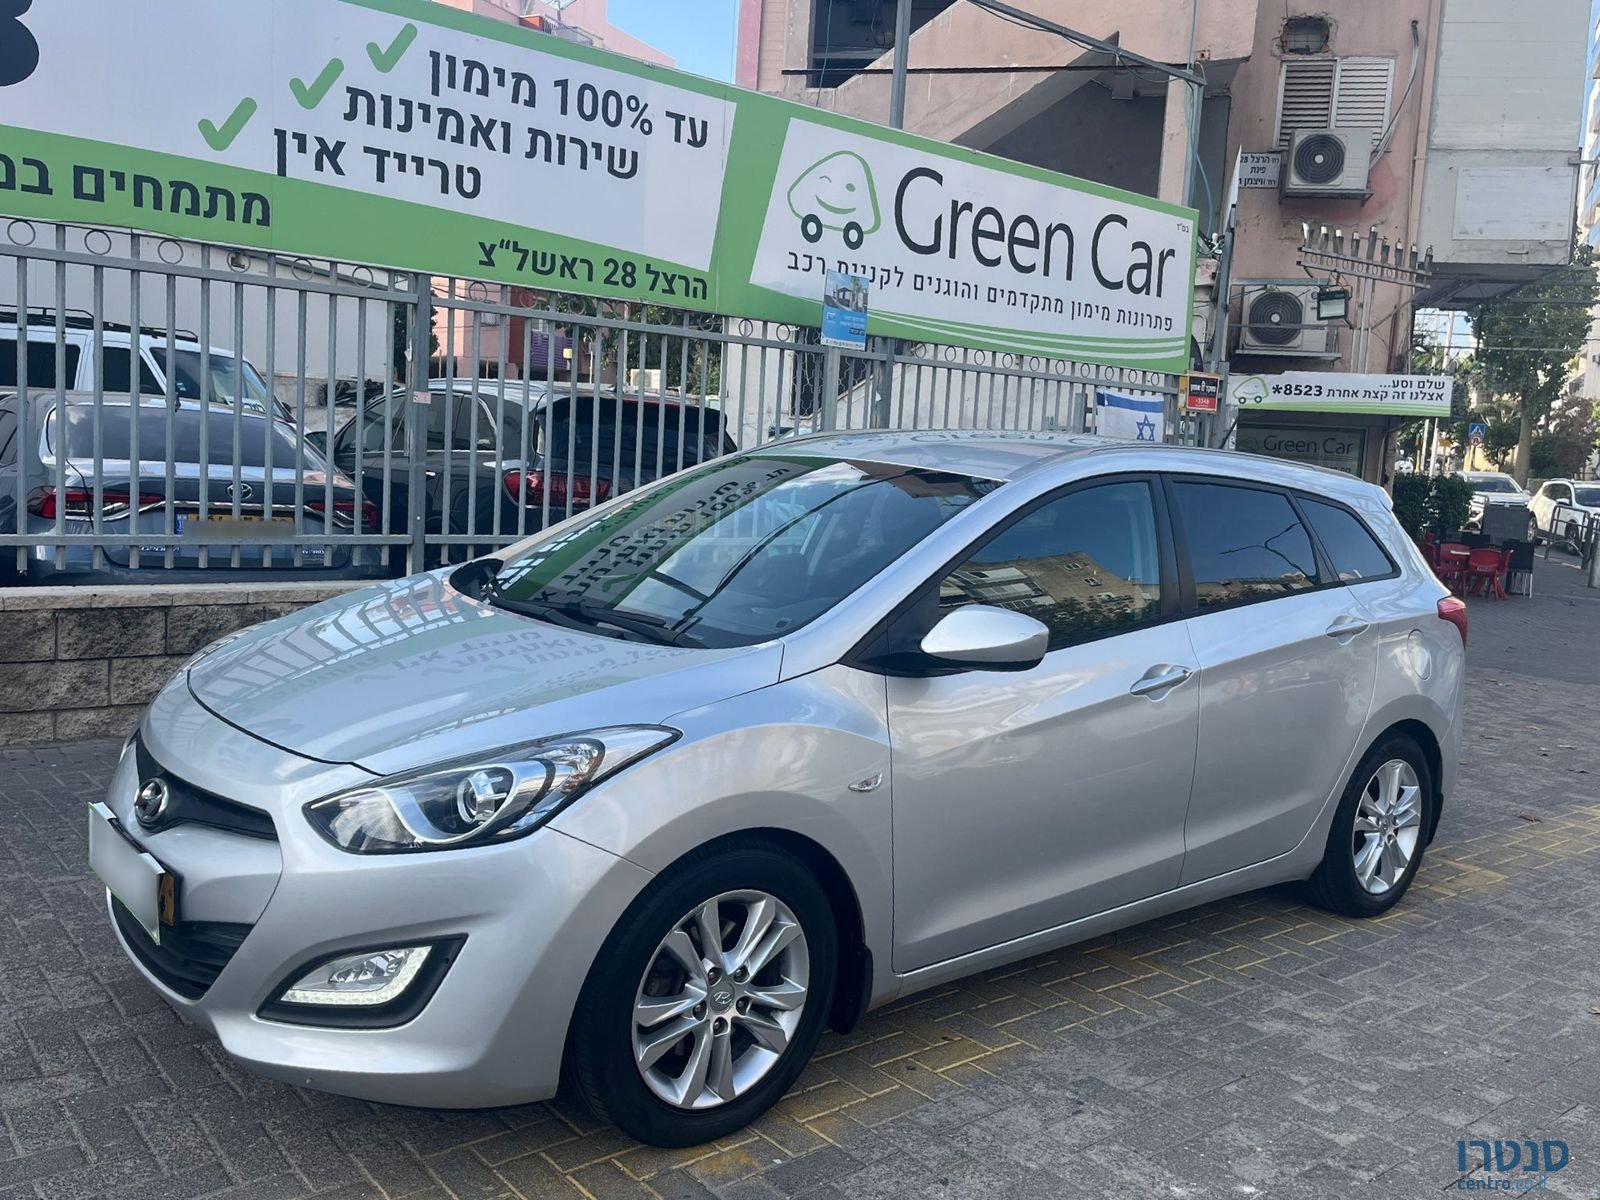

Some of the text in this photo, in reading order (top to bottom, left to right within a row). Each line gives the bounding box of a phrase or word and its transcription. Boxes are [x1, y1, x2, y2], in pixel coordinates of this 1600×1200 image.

[430, 50, 708, 148] עד 100% מימון
[343, 86, 638, 179] שירות ואמינות
[274, 128, 481, 199] טרייד אין
[1250, 166, 1266, 174] פינת
[1251, 154, 1270, 164] הרצל
[73, 164, 271, 227] מתמחים
[894, 167, 1175, 298] Green Car
[603, 258, 637, 289] 28
[787, 252, 826, 275] רכב
[645, 264, 707, 300] הרצל
[914, 274, 978, 300] והוגנים
[987, 286, 1063, 314] מתקדמים
[1071, 300, 1110, 321] מימון
[1117, 308, 1173, 331] פתרונות
[1326, 387, 1359, 398] אחרת
[1362, 389, 1388, 401] קצת
[1392, 390, 1406, 400] זה
[1410, 391, 1444, 401] אצלנו
[1417, 379, 1446, 390] שלם
[1263, 434, 1354, 455] Green Car
